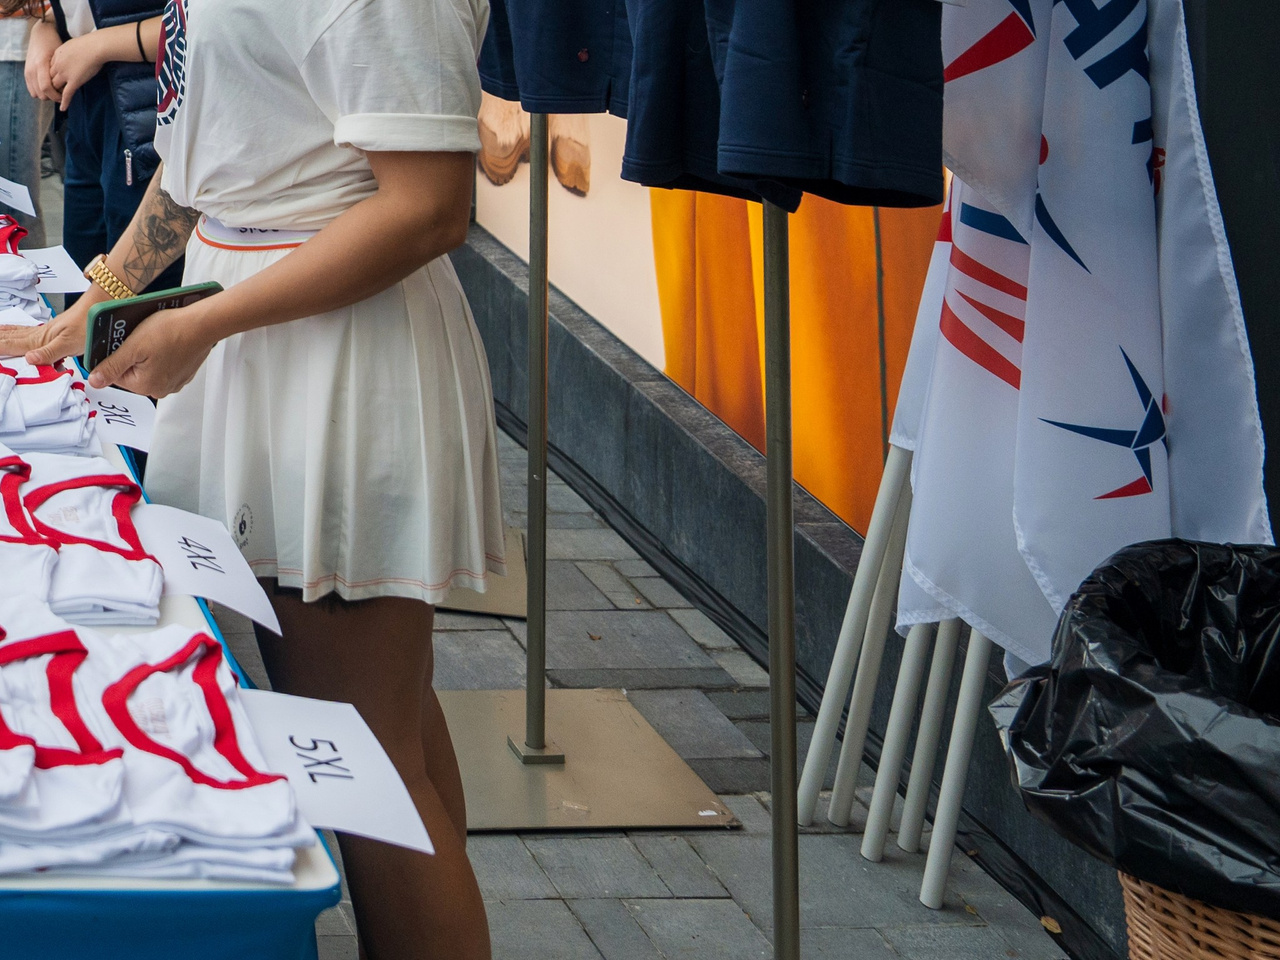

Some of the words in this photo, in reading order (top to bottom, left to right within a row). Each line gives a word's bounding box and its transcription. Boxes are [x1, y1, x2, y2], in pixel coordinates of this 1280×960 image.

[111, 319, 127, 355] 2:50
[97, 400, 137, 427] 3XL
[177, 535, 226, 575] 4XL
[288, 734, 355, 784] 5XL
